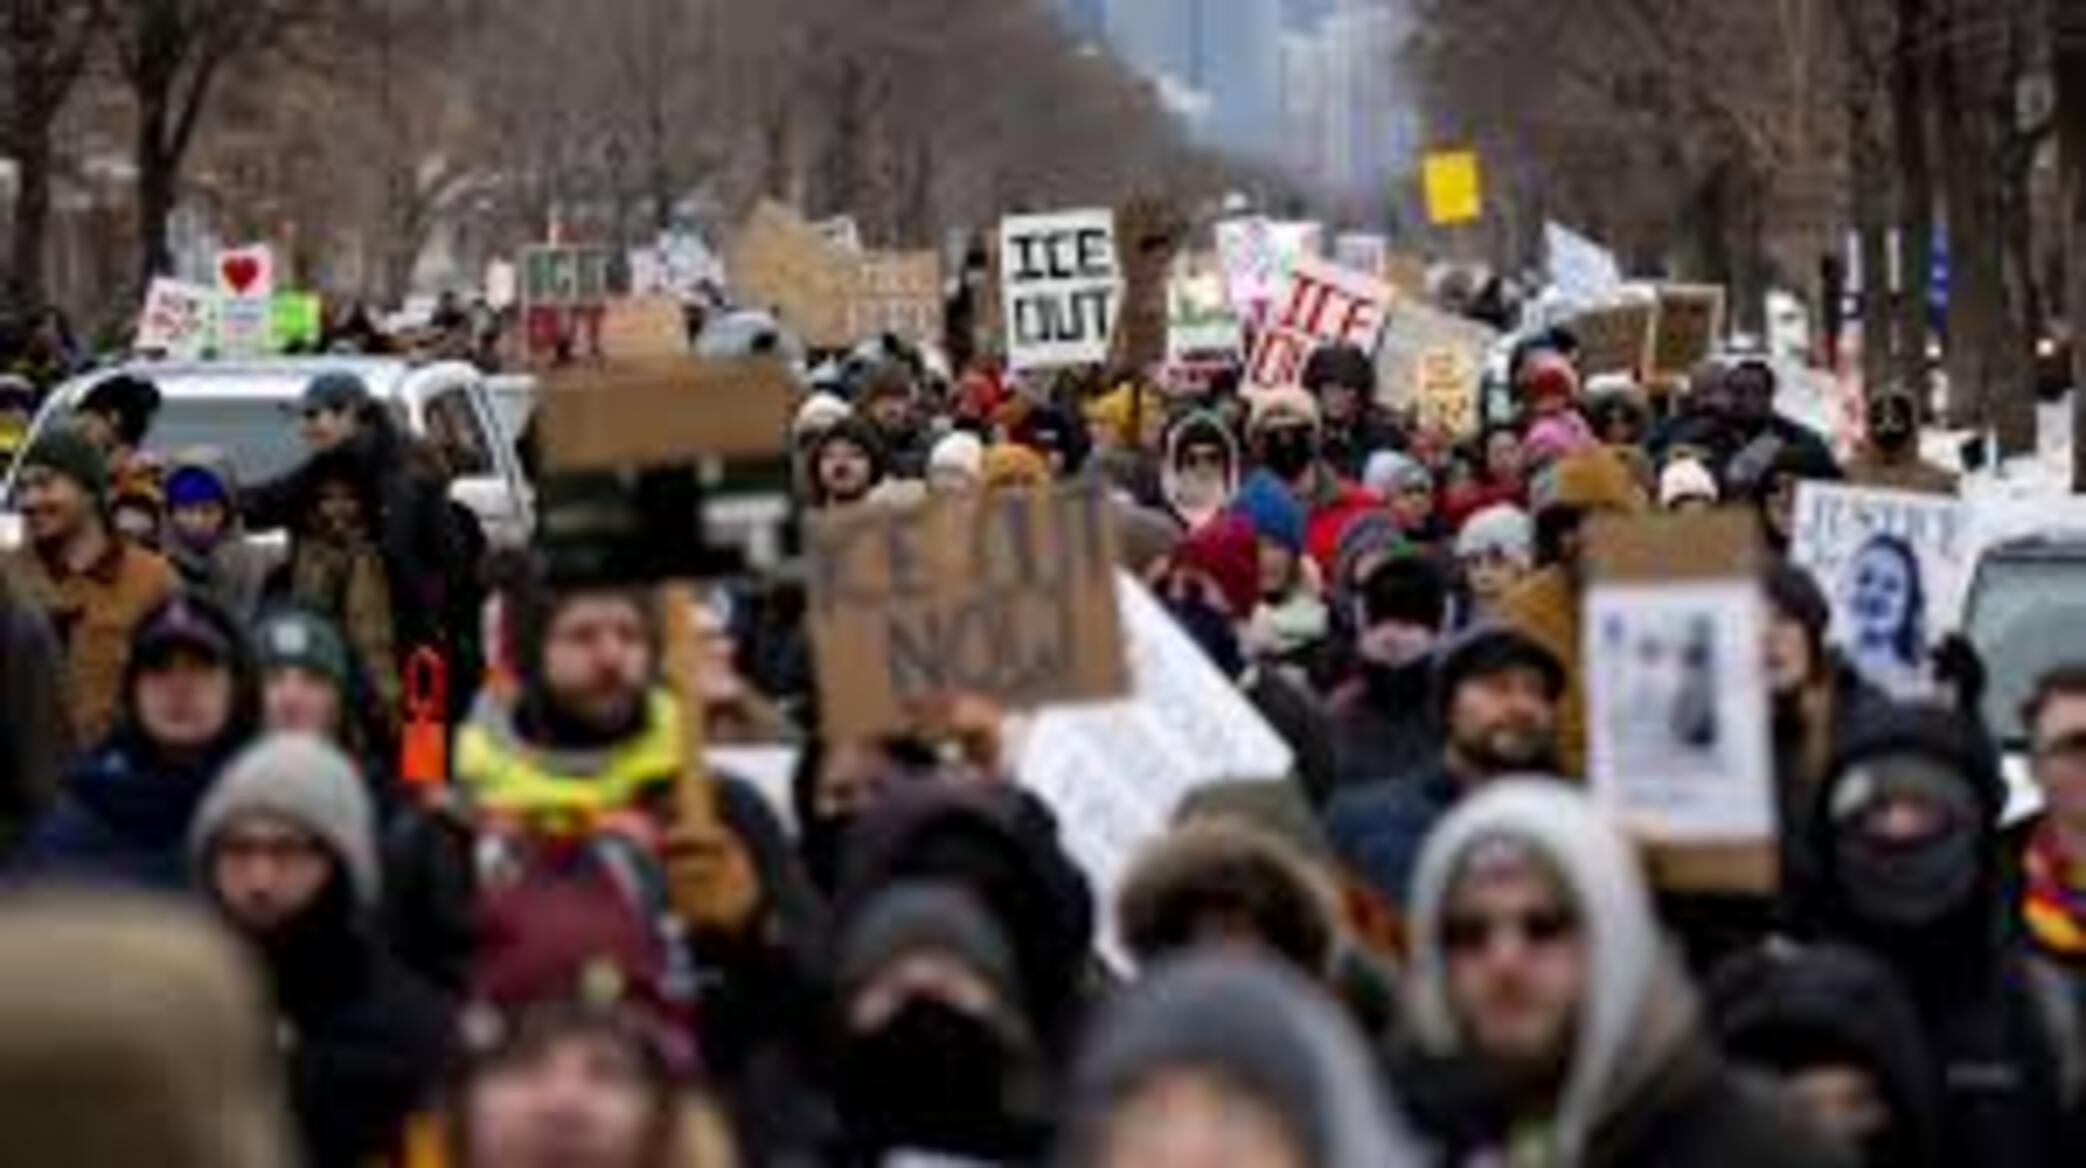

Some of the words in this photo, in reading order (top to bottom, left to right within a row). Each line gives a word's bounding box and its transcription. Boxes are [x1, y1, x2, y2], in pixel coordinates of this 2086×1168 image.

[1008, 228, 1111, 282] ICE
[1014, 284, 1112, 346] OUT
[886, 598, 1075, 690] NOW
